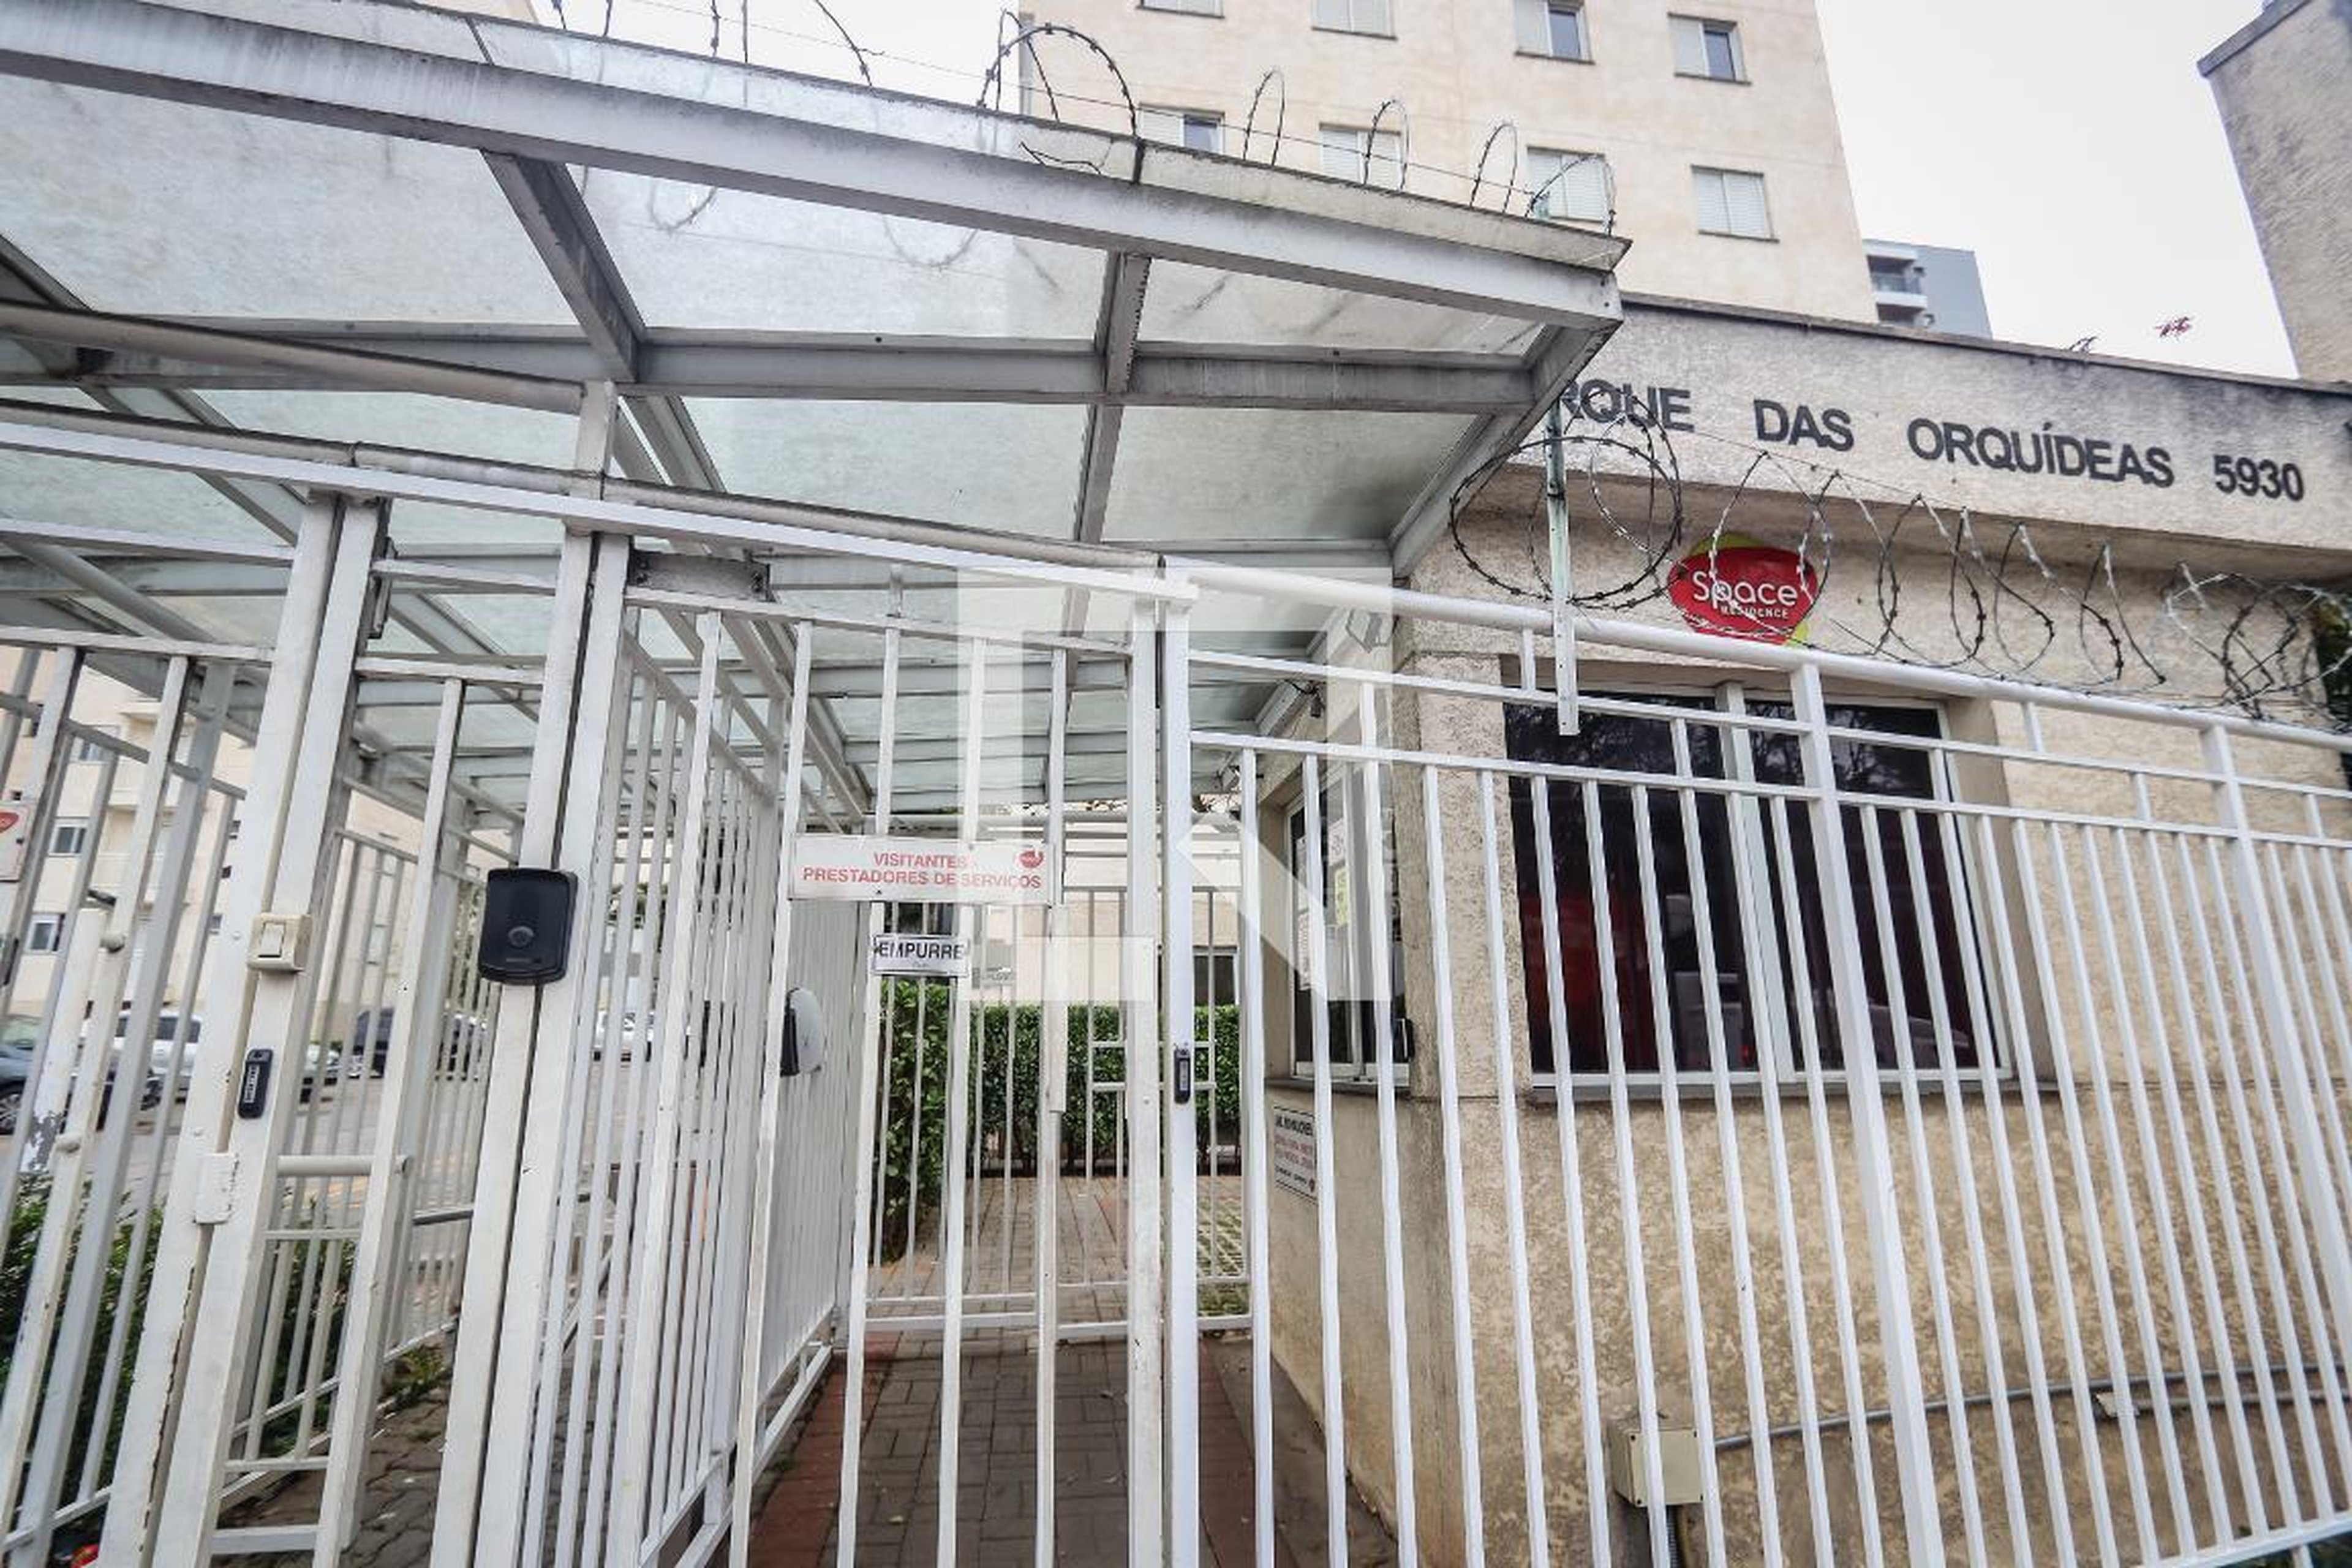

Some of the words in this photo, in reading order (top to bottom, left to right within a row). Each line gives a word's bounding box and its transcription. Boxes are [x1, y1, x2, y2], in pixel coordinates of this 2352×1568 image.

[1754, 399, 1854, 451] DAS
[1907, 418, 2174, 488] ORQUÍDEAS
[2213, 454, 2305, 502] 5930
[1692, 570, 1798, 609] Space
[1721, 606, 1789, 619] REIDENCE
[804, 867, 929, 885] PRESTADORES
[935, 873, 956, 884] DE
[879, 942, 964, 960] EMPURRE
